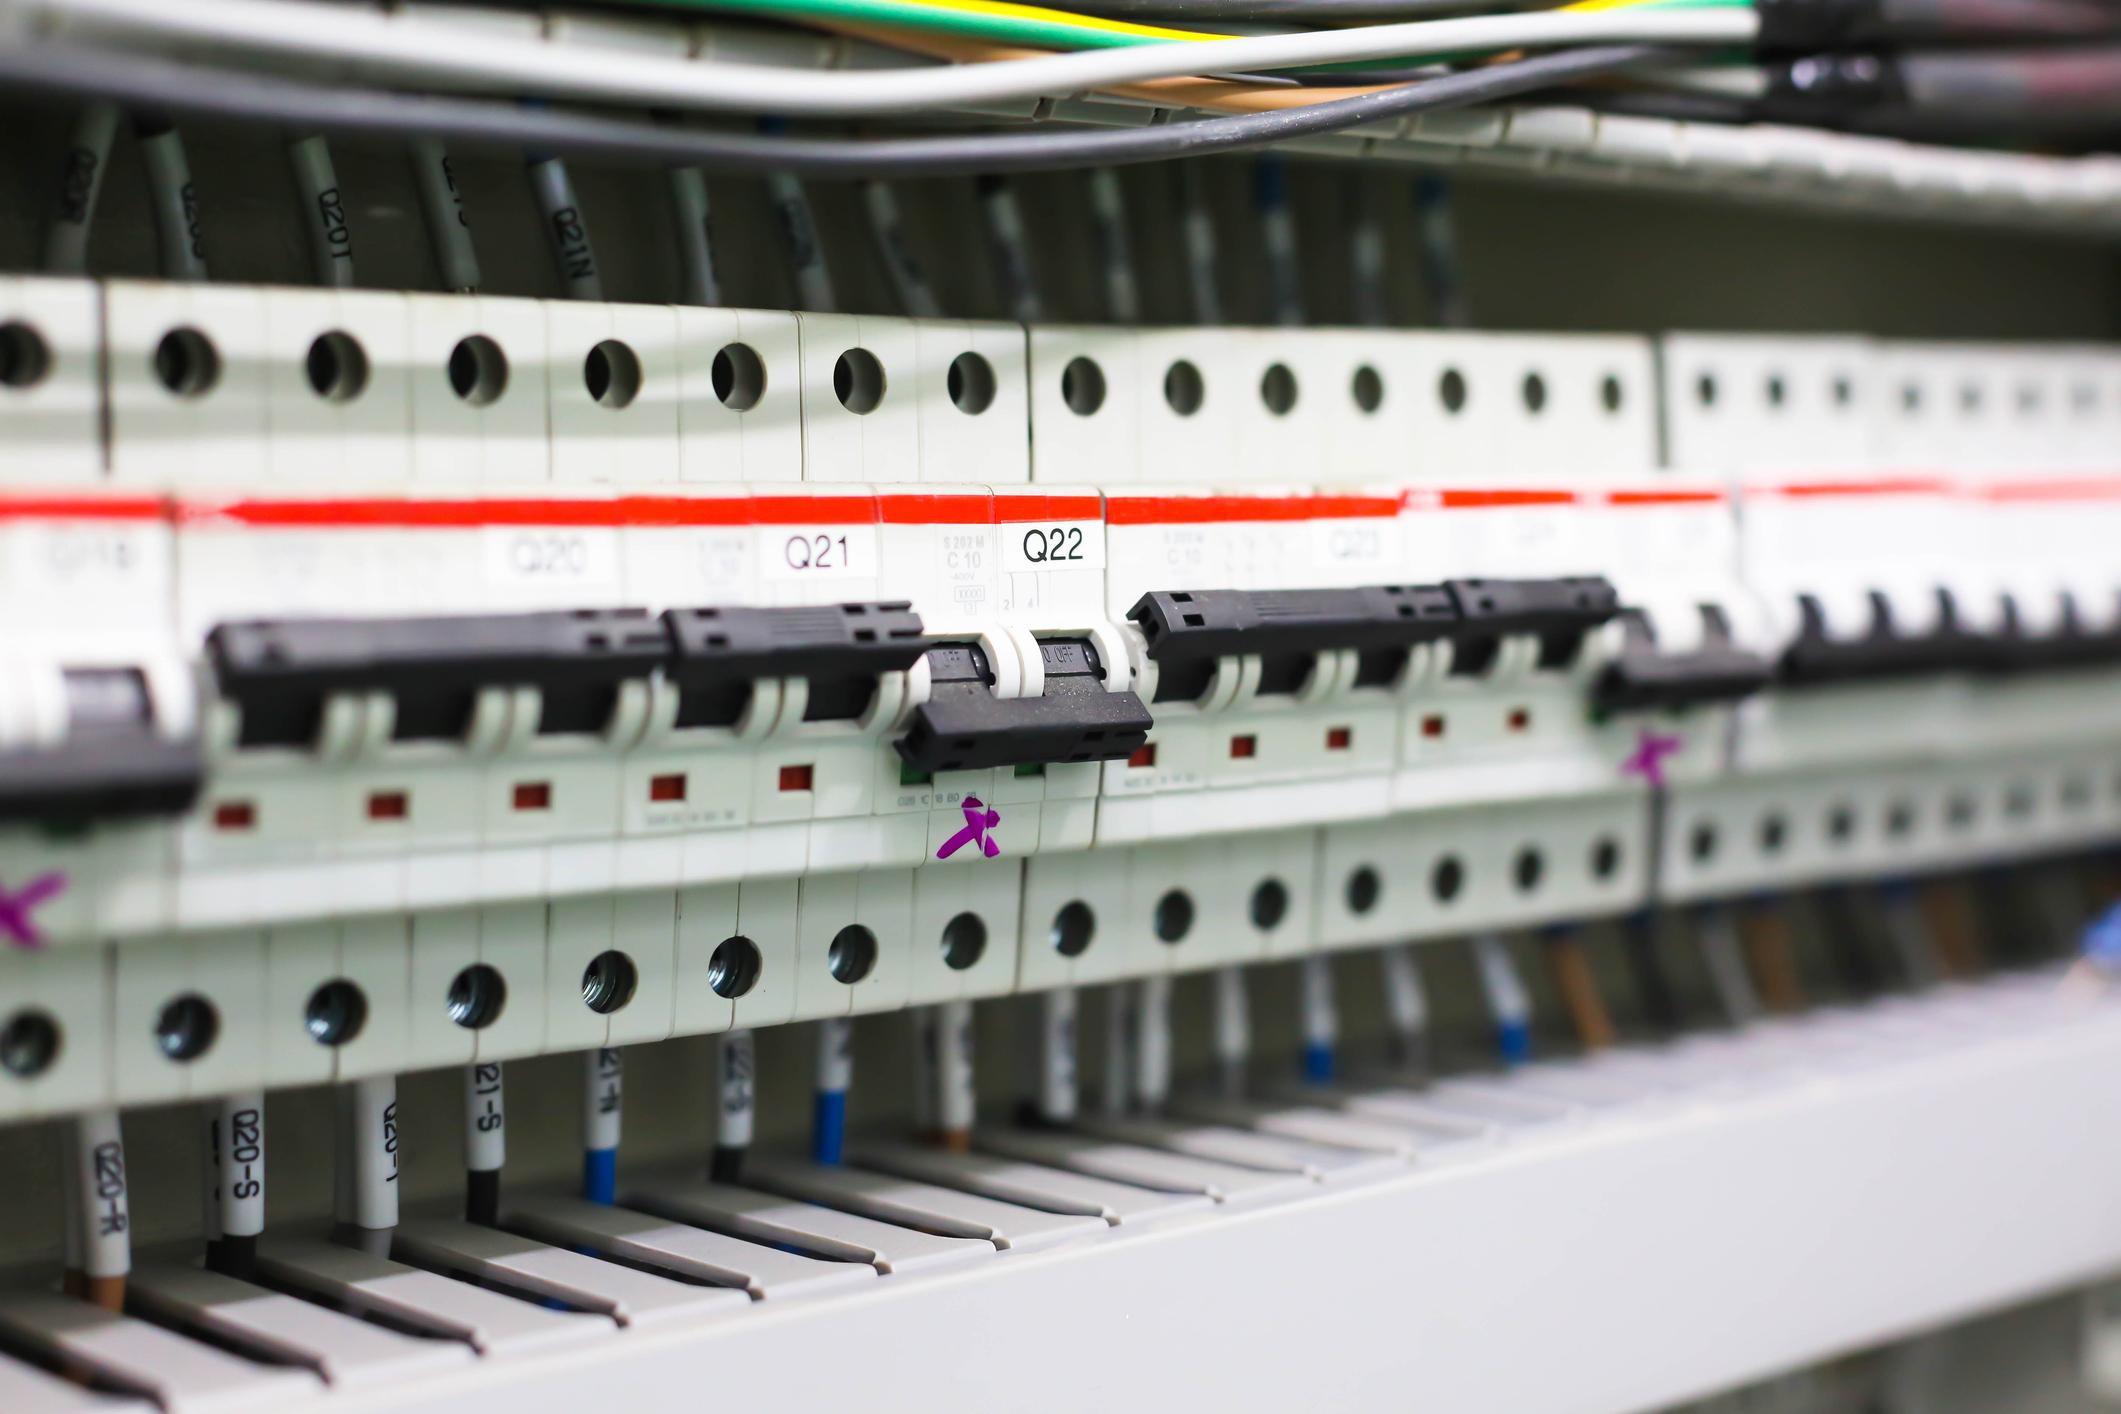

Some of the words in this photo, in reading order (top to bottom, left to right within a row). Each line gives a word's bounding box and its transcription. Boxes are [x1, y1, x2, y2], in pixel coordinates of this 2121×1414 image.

[551, 207, 595, 279] Q21N
[785, 535, 848, 569] Q21
[947, 551, 959, 568] C
[964, 551, 981, 568] 10
[1023, 527, 1083, 562] Q22
[475, 1063, 502, 1132] 21-S
[94, 1141, 127, 1236] Q20-R
[232, 1109, 260, 1199] Q20-S
